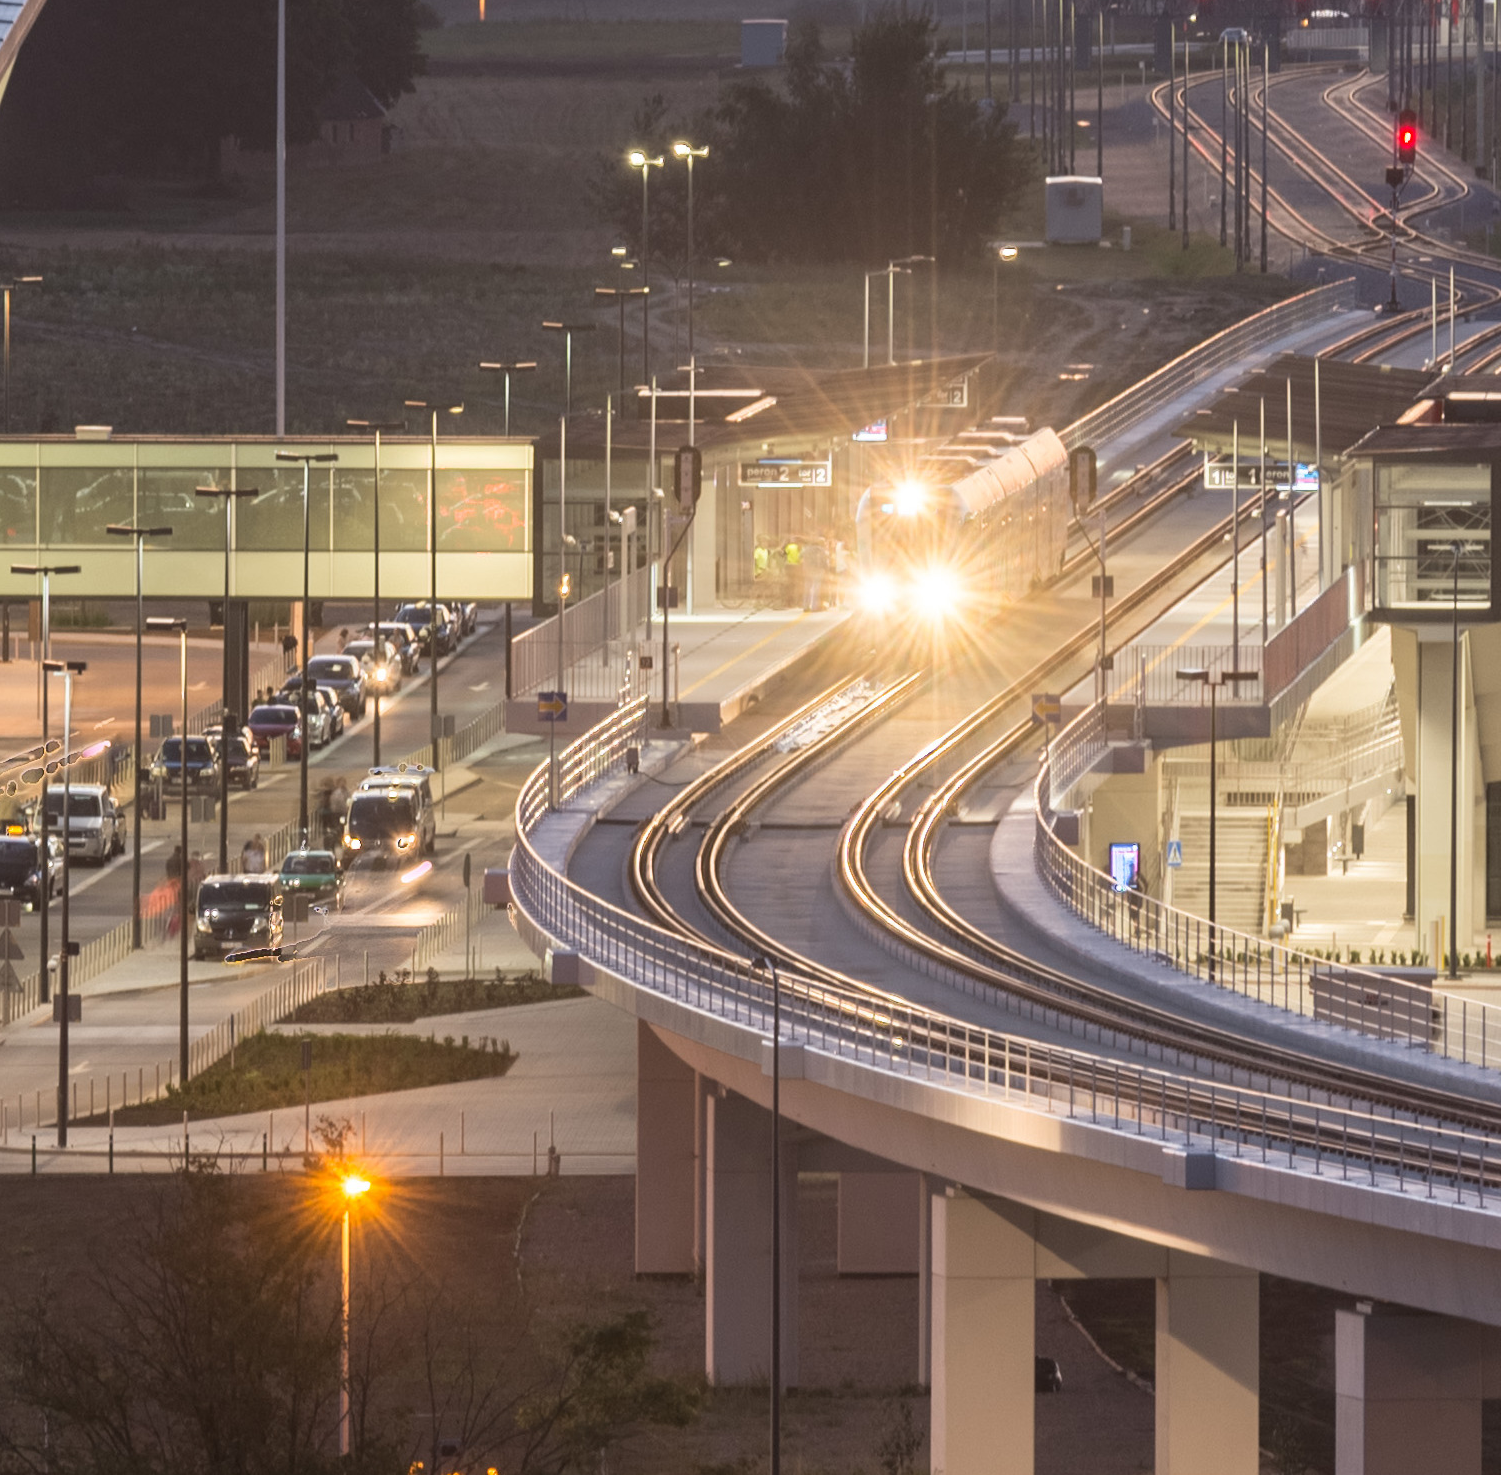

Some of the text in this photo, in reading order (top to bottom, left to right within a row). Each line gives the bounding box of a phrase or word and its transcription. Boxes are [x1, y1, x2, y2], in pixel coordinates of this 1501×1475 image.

[779, 466, 789, 482] 2
[816, 468, 826, 482] 2
[1259, 470, 1290, 479] eron
